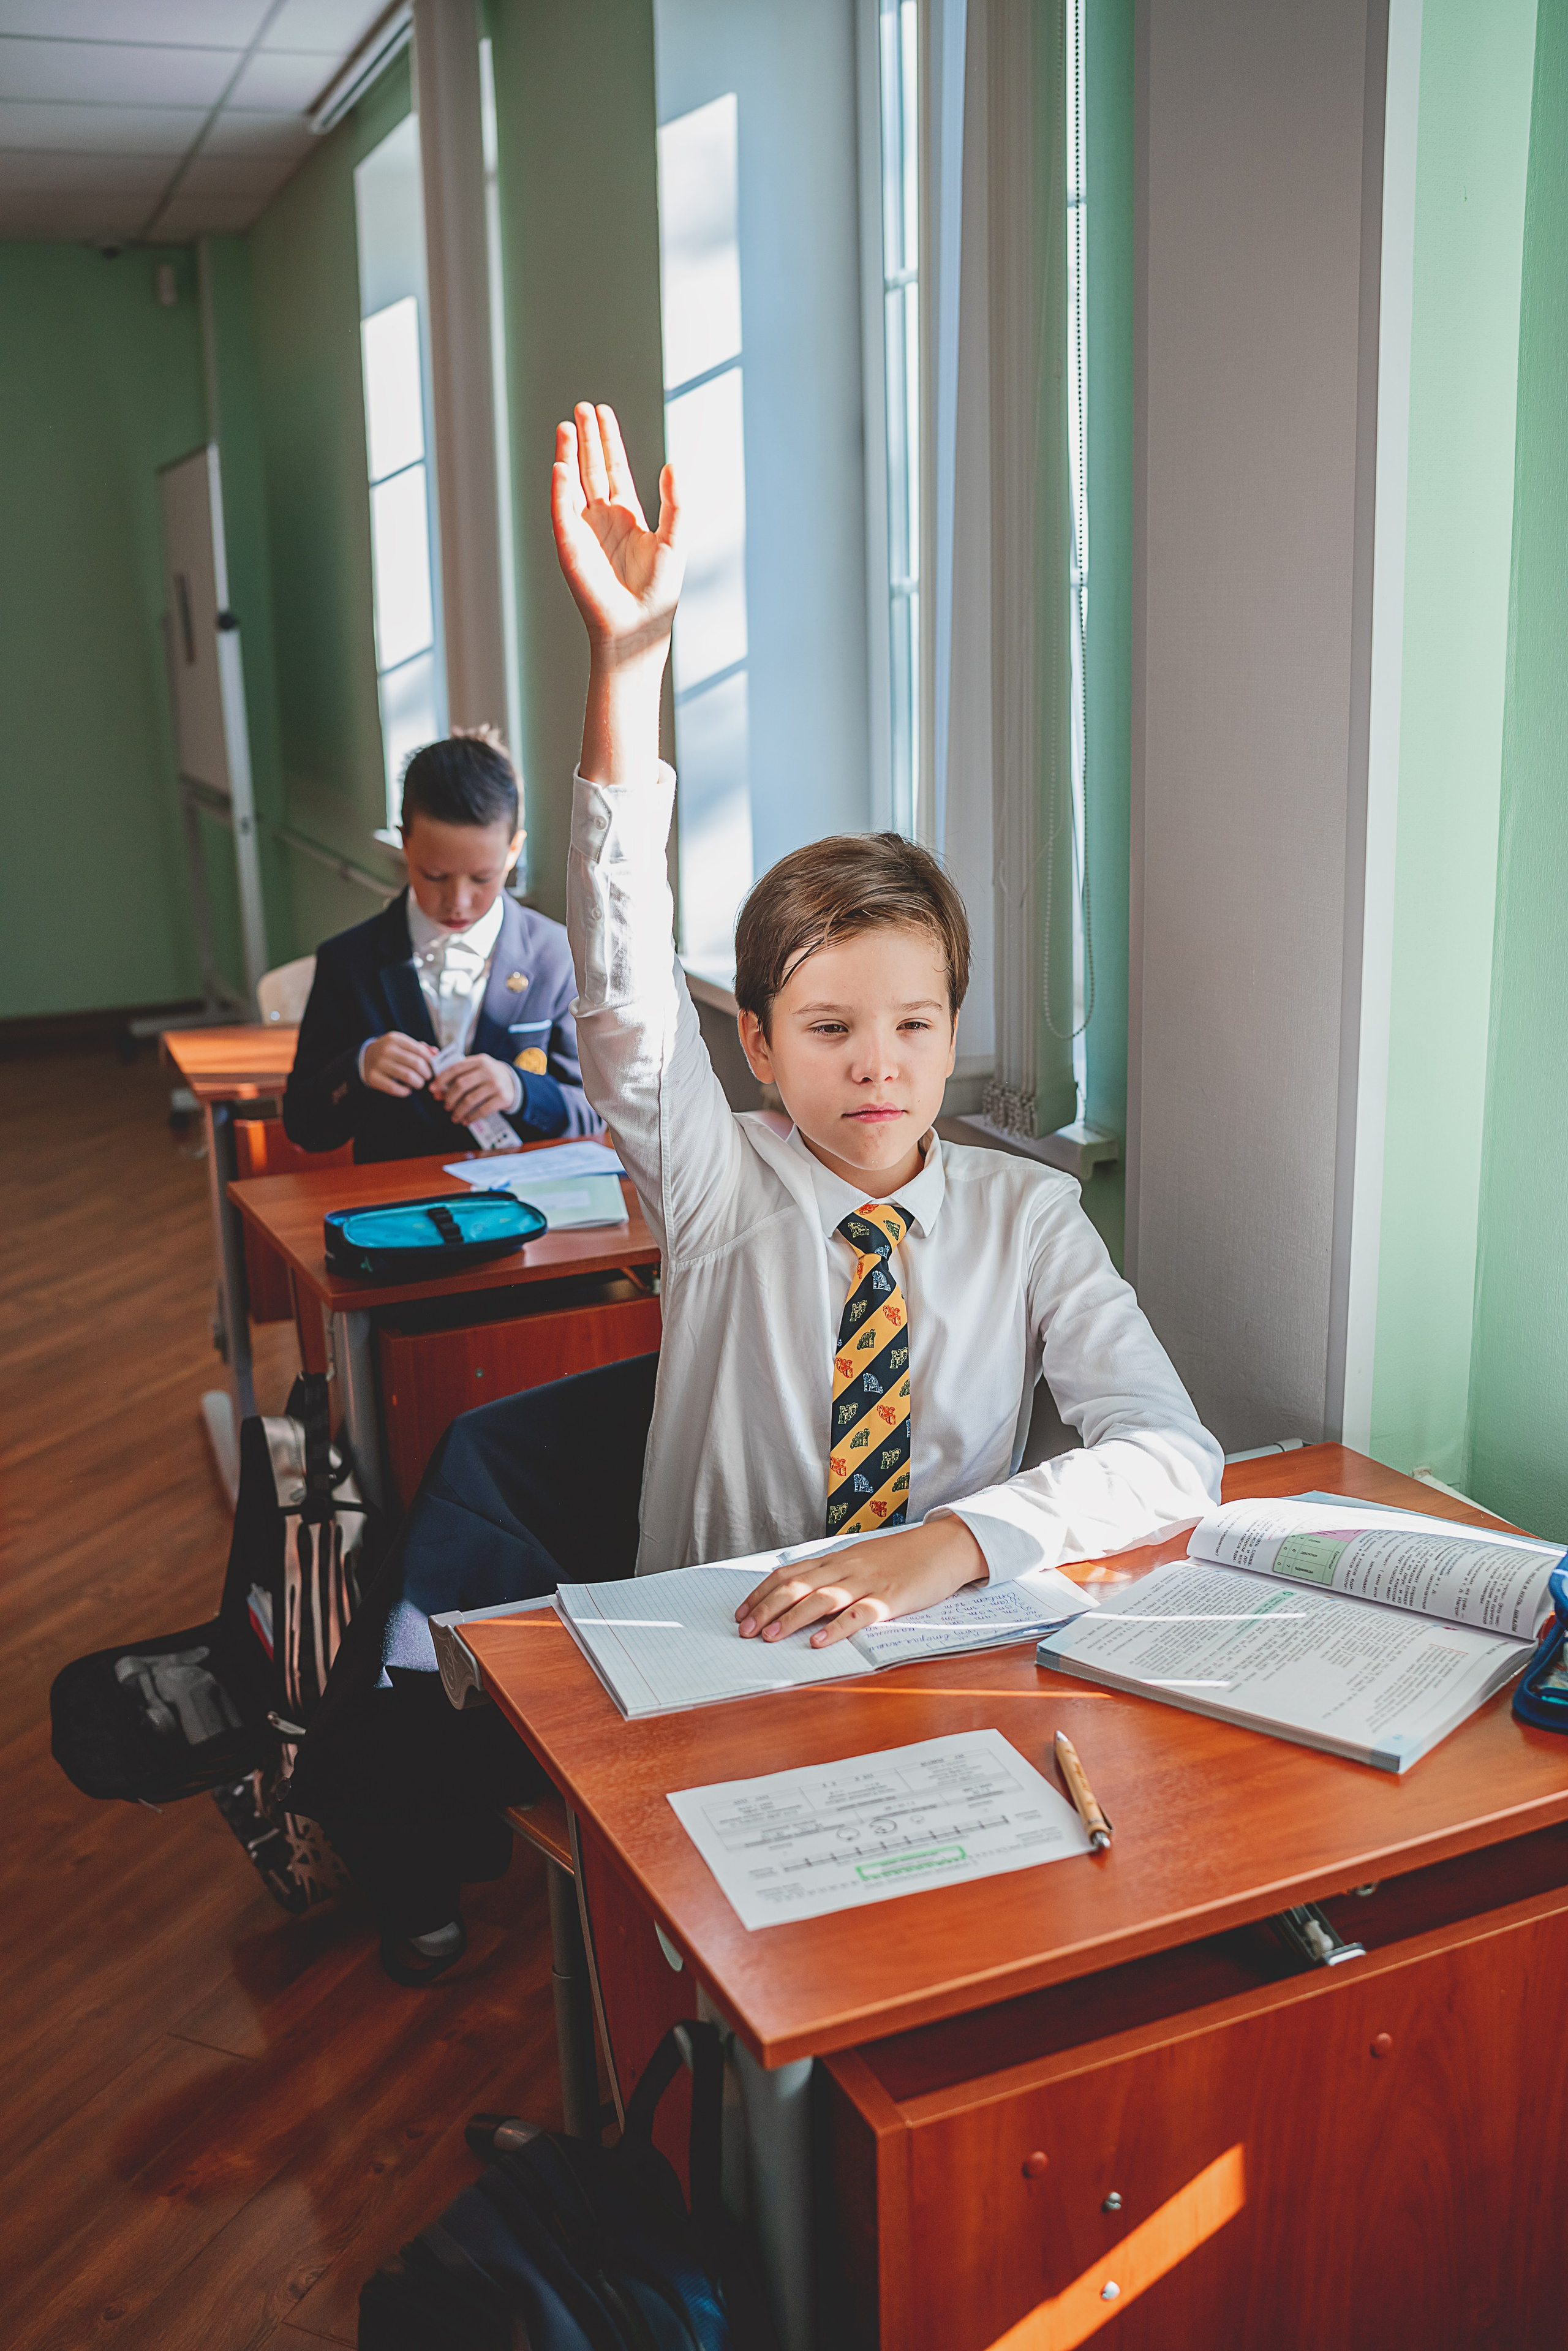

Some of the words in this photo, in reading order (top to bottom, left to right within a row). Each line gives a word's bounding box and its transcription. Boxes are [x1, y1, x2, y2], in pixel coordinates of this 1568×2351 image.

[1215, 1530, 1229, 1557] предметов?
[1237, 1533, 1247, 1549] класса
[1241, 1533, 1253, 1552] котором
[1249, 1532, 1259, 1547] класса
[1247, 1549, 1256, 1566] слева,
[1349, 1552, 1359, 1568] классе
[1352, 1558, 1362, 1576] классе
[1343, 1570, 1351, 1590] милли-
[1361, 1561, 1375, 1593] записывают:
[1389, 1566, 1399, 1585] классы
[1400, 1572, 1408, 1586] двух,
[1408, 1564, 1419, 1583] каждом
[1414, 1558, 1430, 1583] разбивают
[1422, 1574, 1434, 1609] пятизначные
[1480, 1580, 1491, 1604] команды.
[1488, 1580, 1498, 1599] вторая
[1453, 1596, 1462, 1616] Напри-
